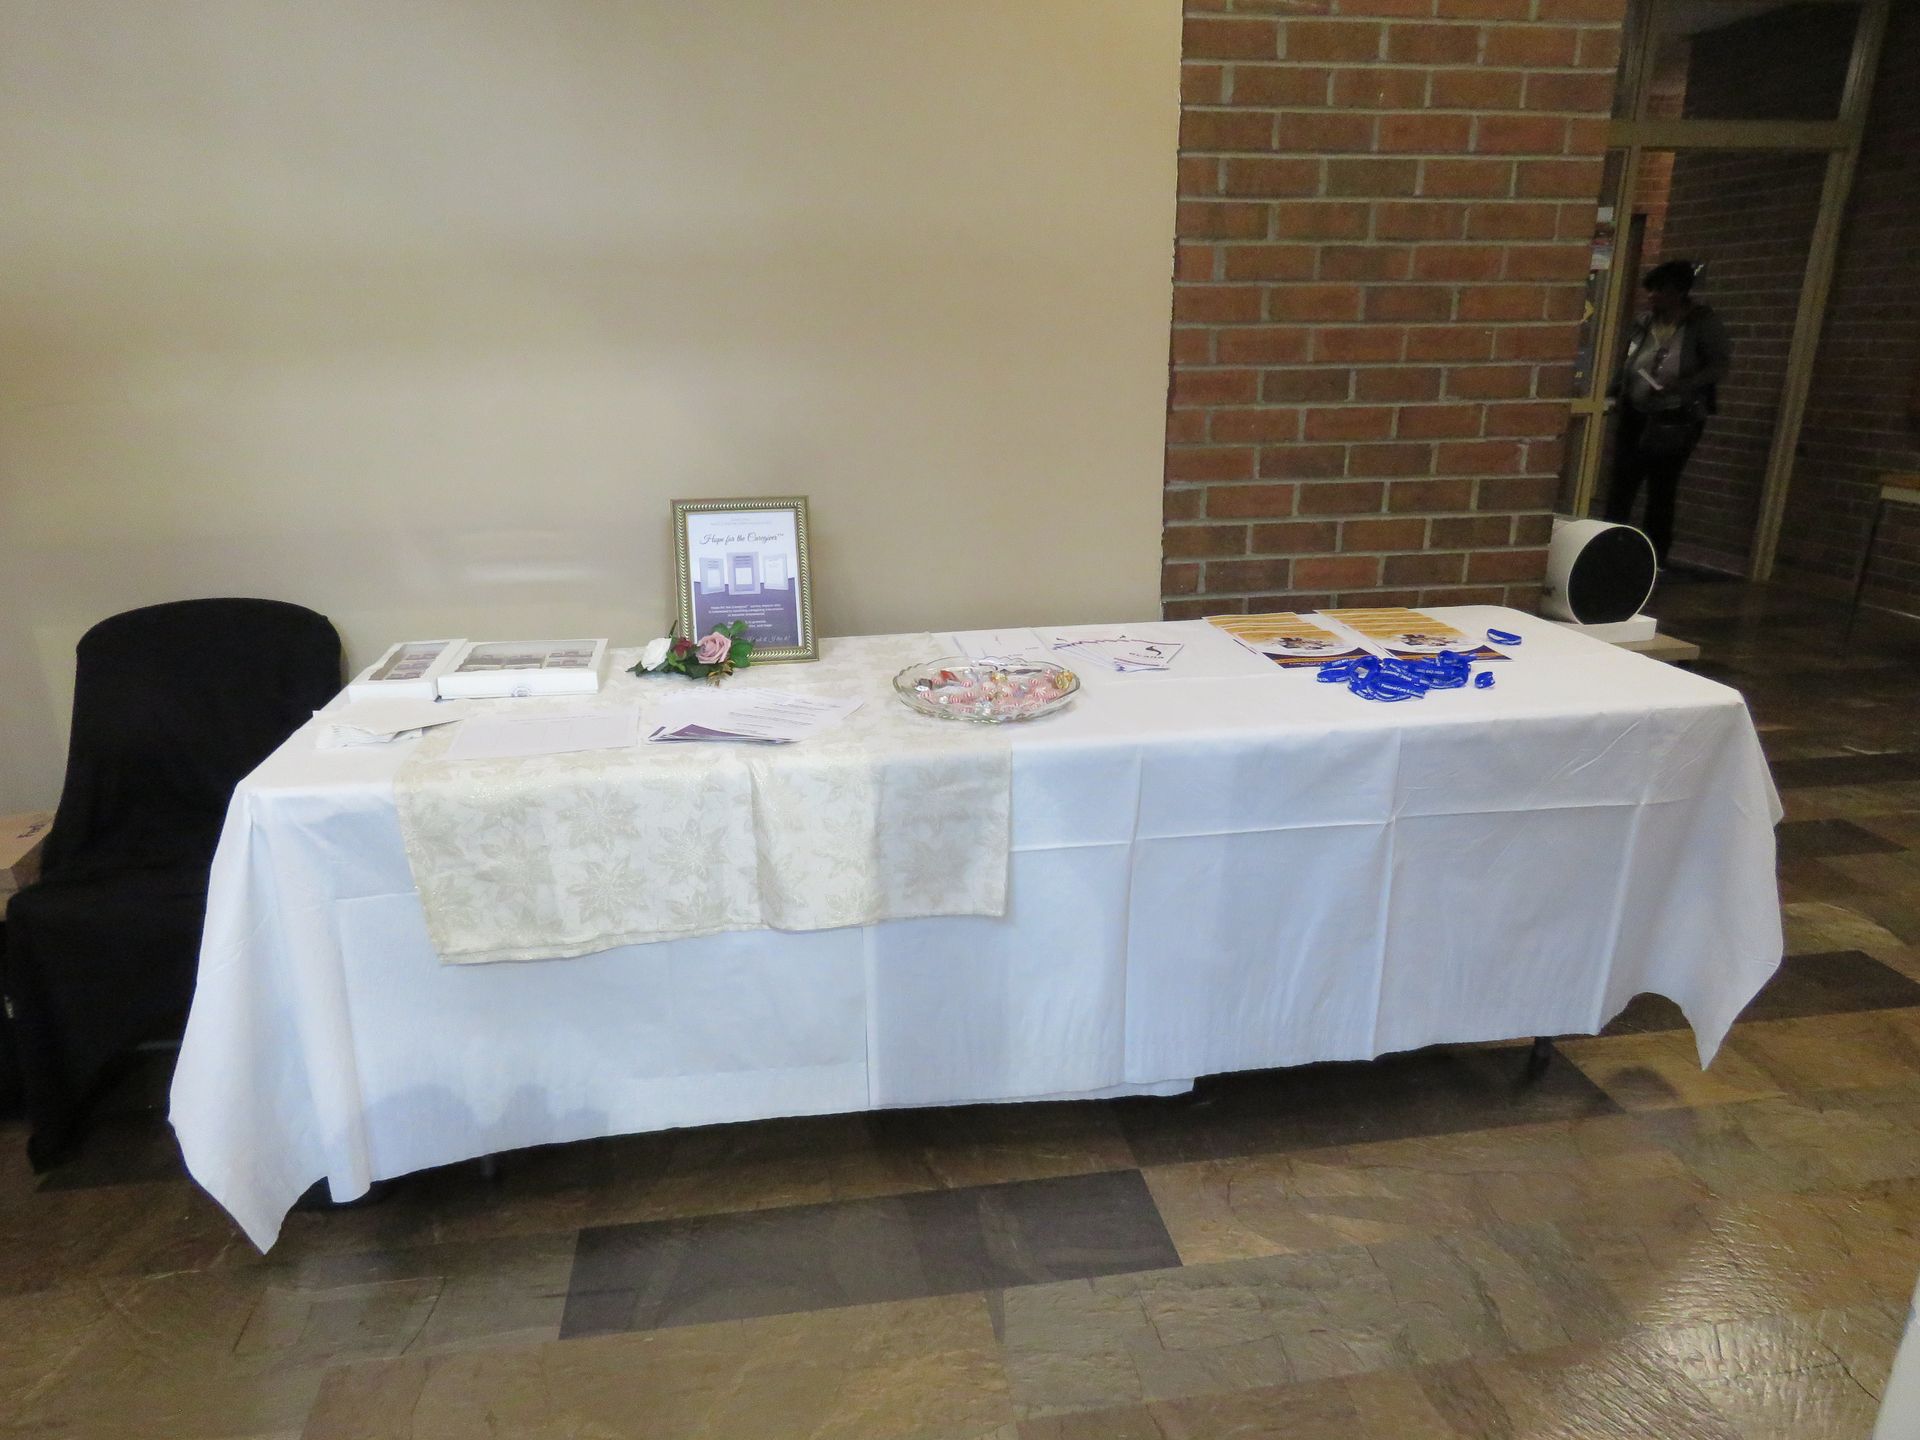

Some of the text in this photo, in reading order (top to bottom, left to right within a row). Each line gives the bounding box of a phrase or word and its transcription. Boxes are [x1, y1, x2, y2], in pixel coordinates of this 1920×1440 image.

[700, 533, 724, 545] Hope
[725, 535, 735, 546] for
[737, 534, 745, 542] the
